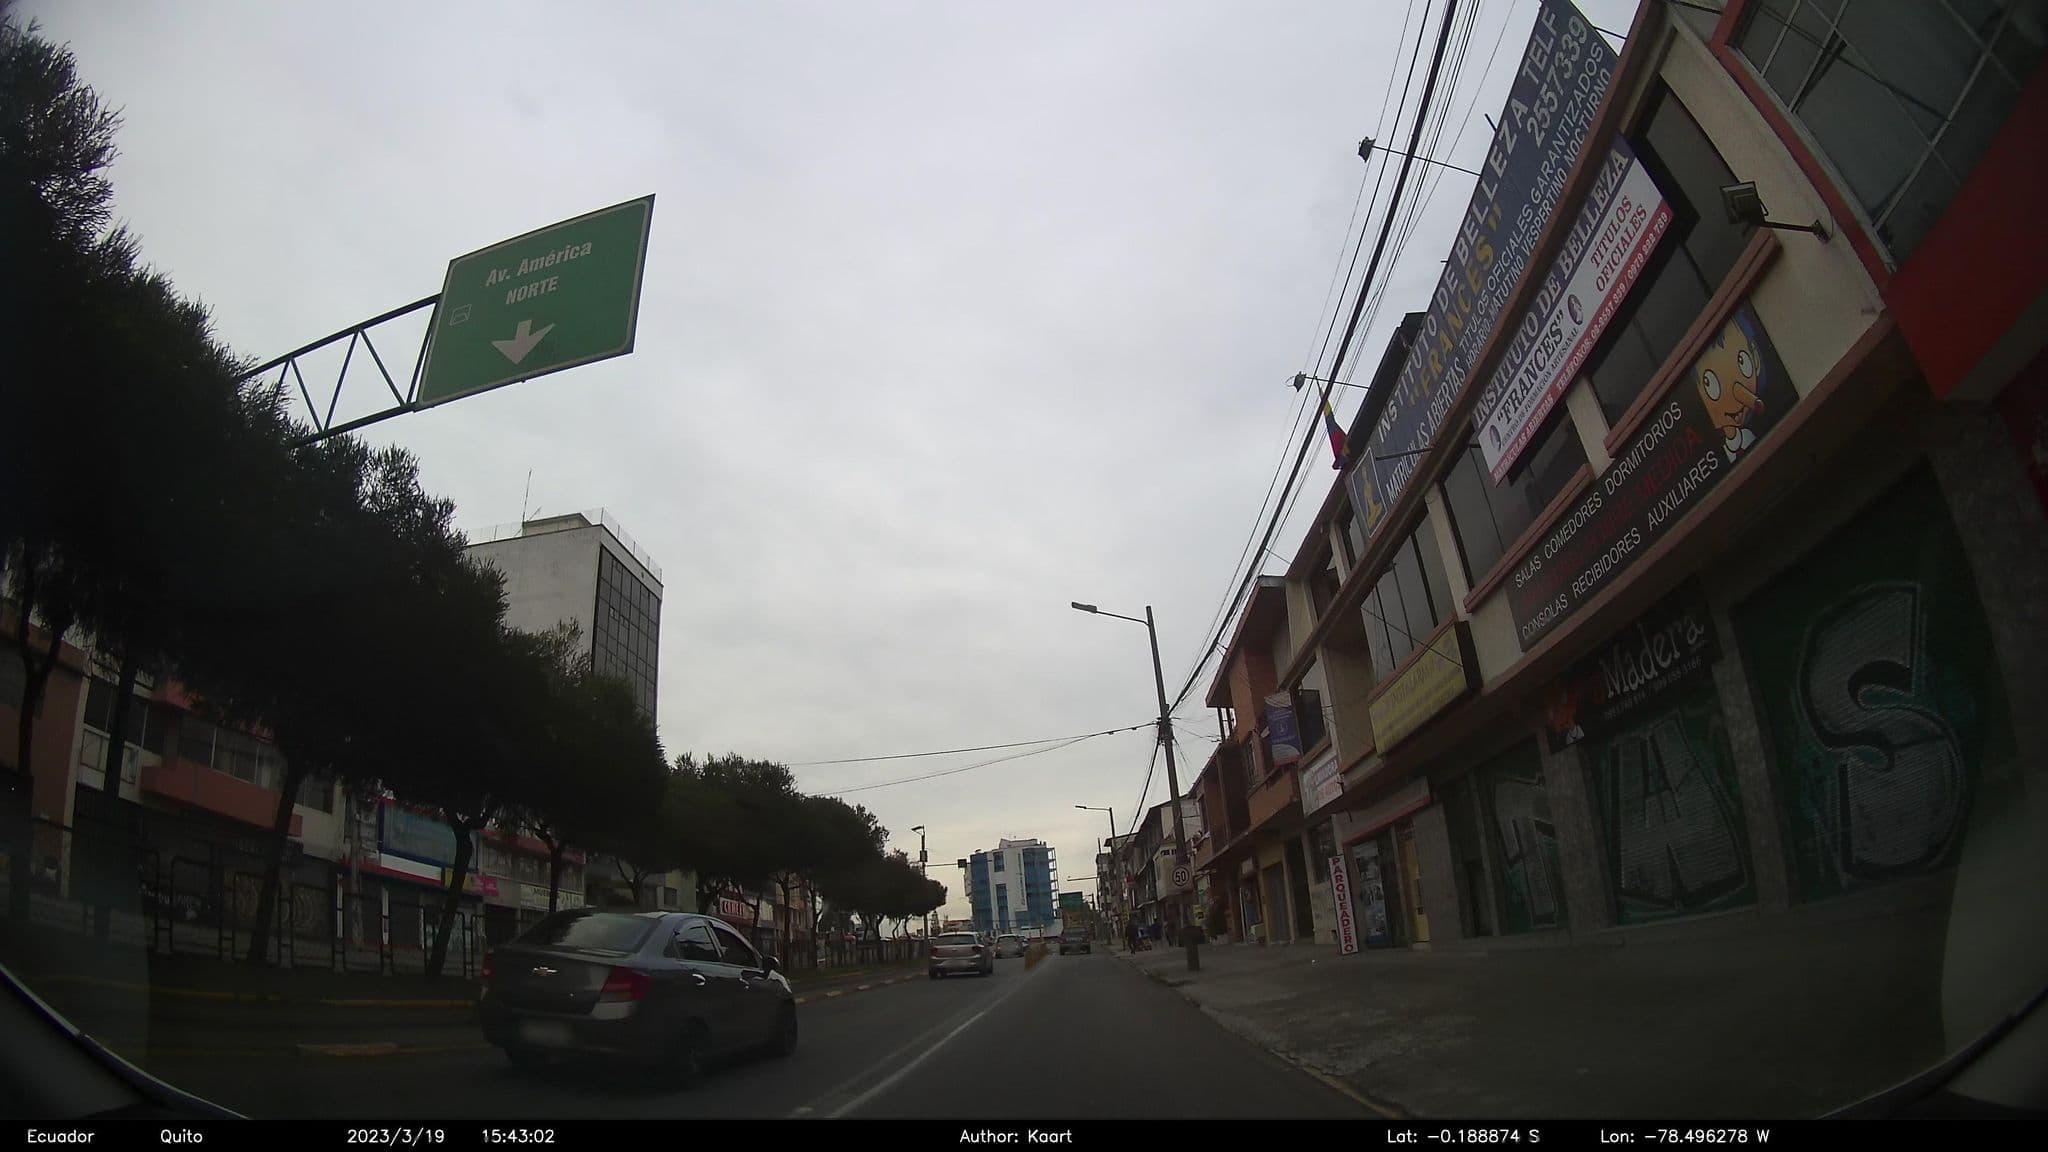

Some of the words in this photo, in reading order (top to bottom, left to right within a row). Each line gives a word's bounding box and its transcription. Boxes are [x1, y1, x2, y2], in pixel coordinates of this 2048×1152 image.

[1526, 15, 1588, 148] 2557339
[1377, 314, 1437, 443] INSTITUTO
[1438, 264, 1459, 313] DE
[1455, 98, 1529, 267] BELLEZA
[1522, 7, 1557, 84] TELF
[1426, 357, 1466, 435] ABIERTAS
[1459, 289, 1490, 354] TITULOS
[1487, 203, 1533, 292] OFICIALES
[1530, 41, 1604, 204] GARANTIZADOS
[1488, 256, 1525, 321] MATUTINO
[1521, 167, 1568, 257] VESPERTINO
[1564, 68, 1611, 168] NOCTURNO
[1595, 204, 1648, 292] OFICIALES
[485, 268, 511, 287] Av.
[517, 241, 593, 277] América
[505, 276, 559, 305] NORTE
[1473, 311, 1539, 428] INSTITUTO
[1536, 273, 1562, 319] DE
[1556, 149, 1630, 280] BELLEZA
[1515, 555, 1542, 588] SALAS
[1544, 491, 1603, 559] COMEDORES
[1604, 401, 1683, 496] DORMITORIOS
[1522, 593, 1568, 640] CONSOLAS
[1571, 527, 1641, 599] RECIBIDORES
[1647, 450, 1719, 531] AUXILIARES
[1600, 615, 1704, 699] Madera
[1174, 871, 1186, 883] 50
[1332, 857, 1354, 953] PARQUEADERO
